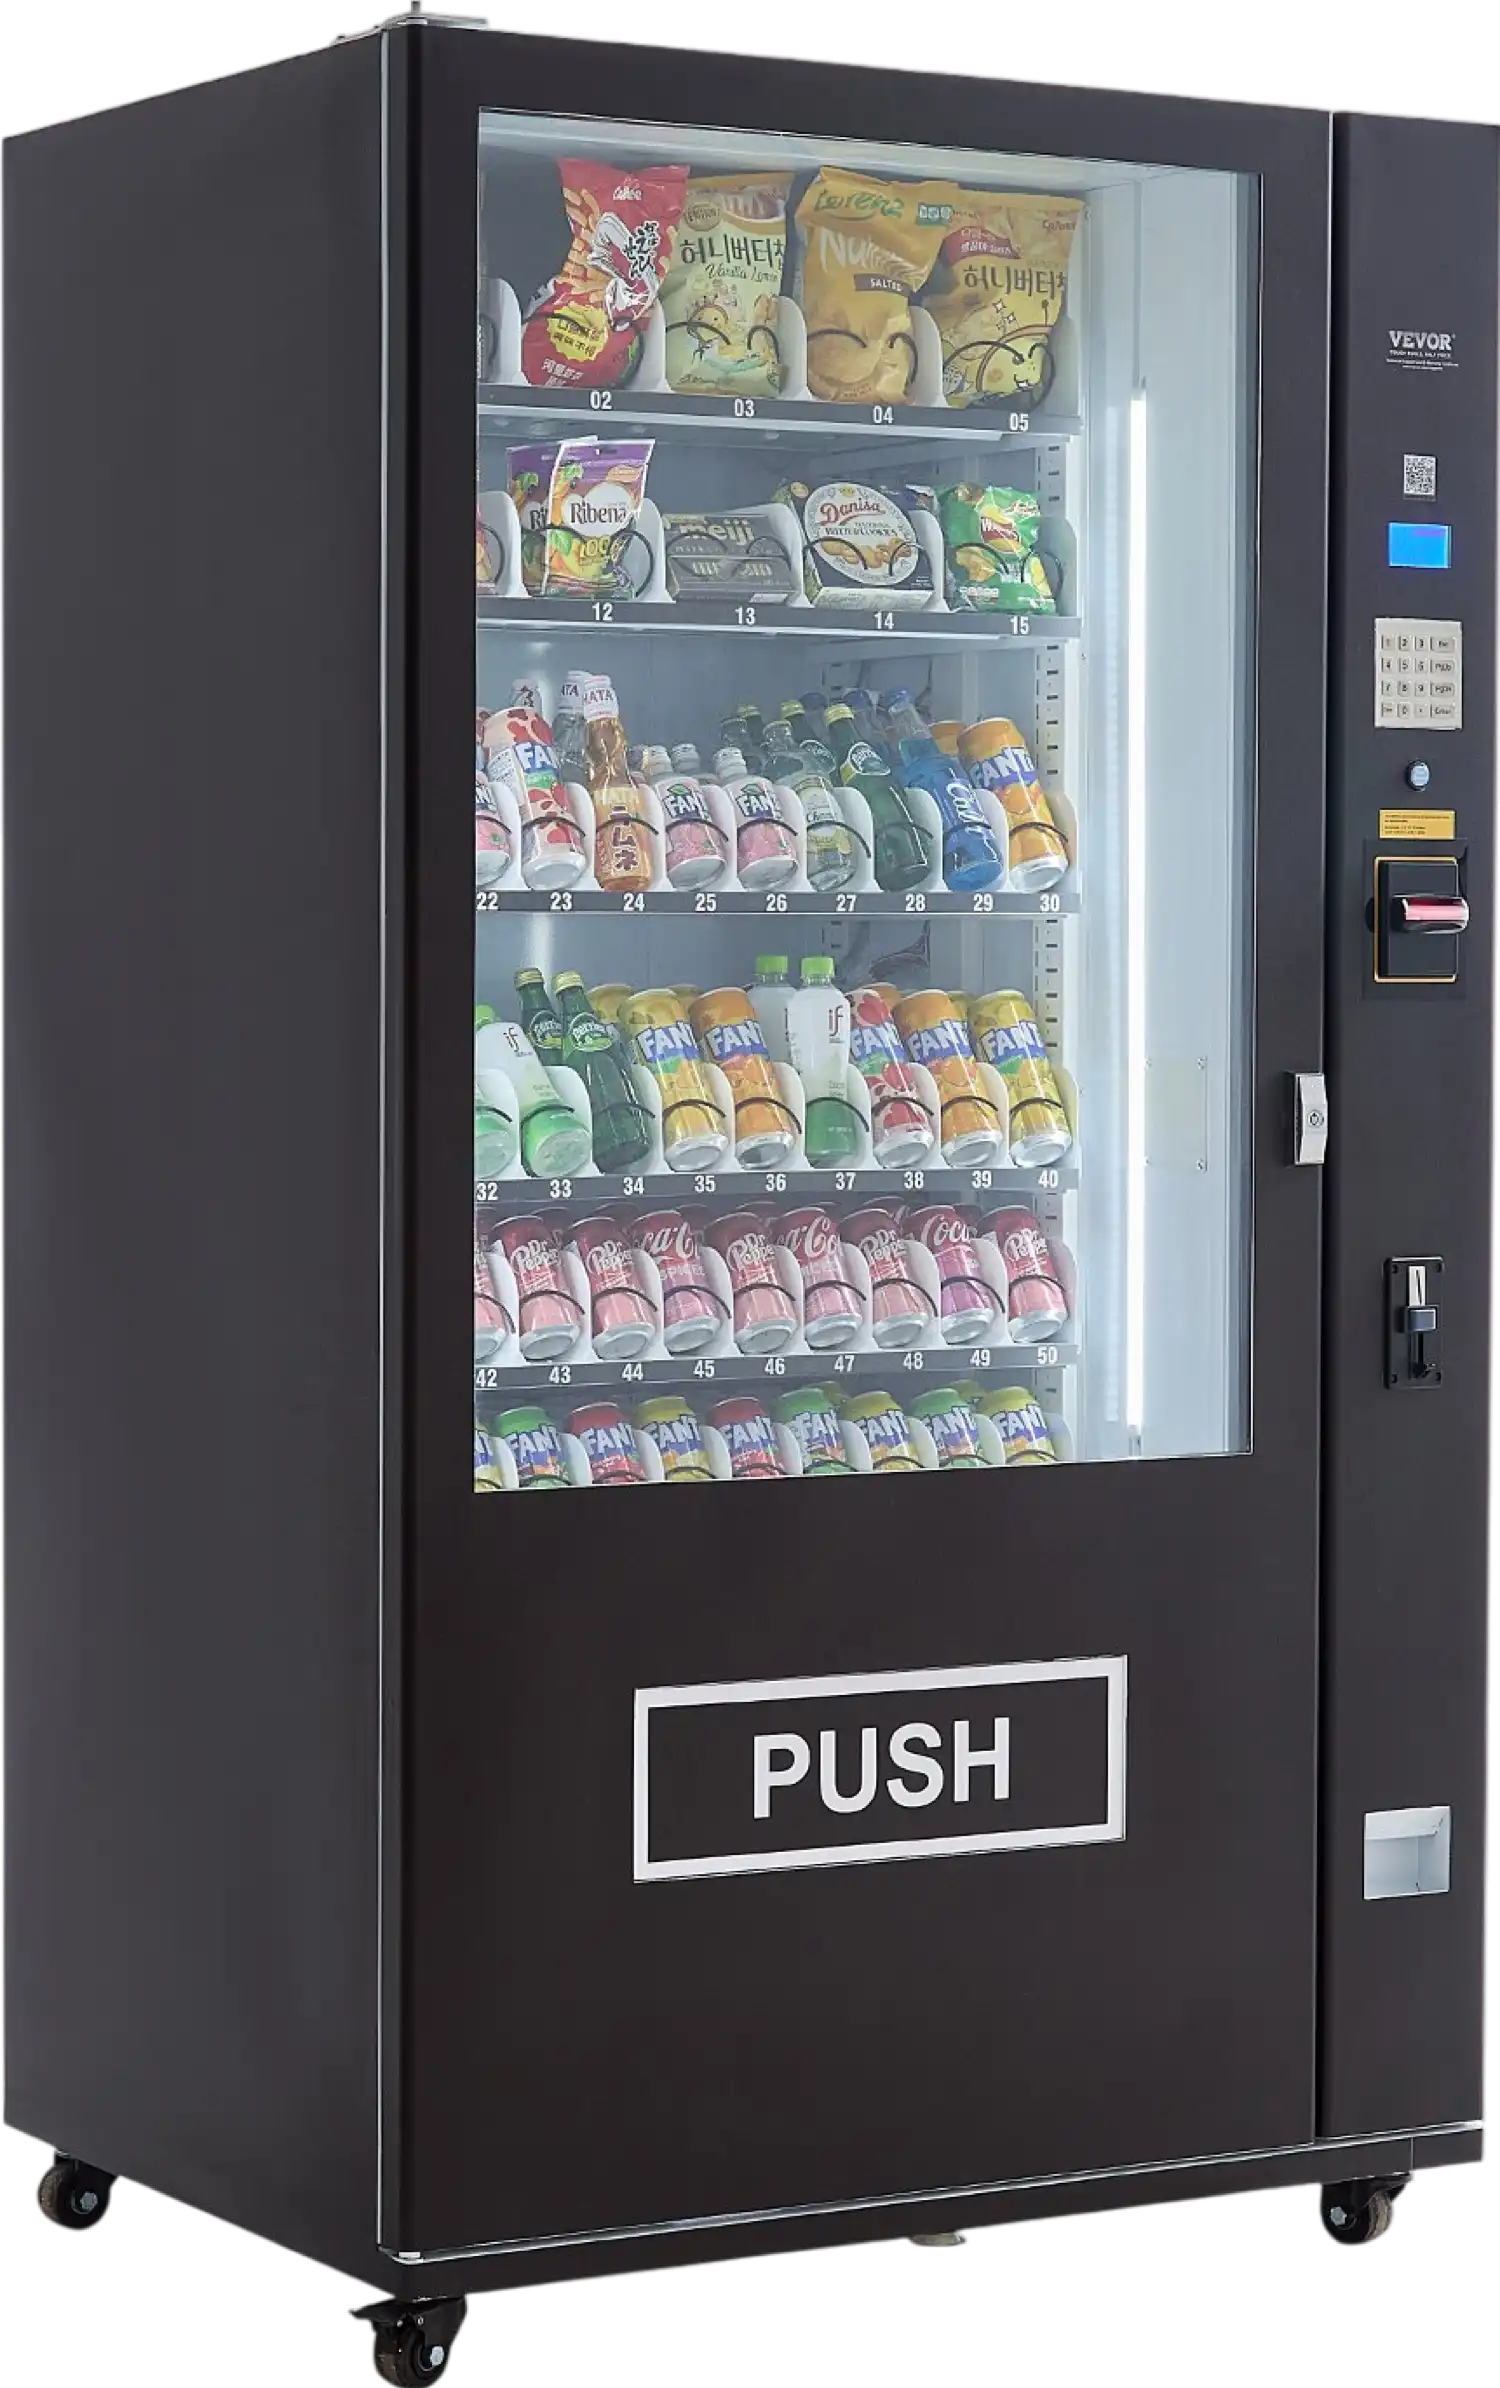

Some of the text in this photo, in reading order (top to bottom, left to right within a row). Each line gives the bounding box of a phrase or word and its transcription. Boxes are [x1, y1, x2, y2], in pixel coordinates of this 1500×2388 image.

[1388, 330, 1453, 351] VEVOR
[590, 391, 612, 410] 02
[734, 399, 755, 417] 03
[872, 406, 894, 424] 04
[1009, 413, 1029, 431] 05
[570, 502, 628, 524] Ribena
[818, 497, 886, 526] Danisa
[678, 518, 756, 546] meiji
[591, 602, 613, 621] 12
[734, 606, 756, 625] 13
[874, 611, 895, 630] 14
[1010, 617, 1029, 635] 15
[477, 892, 498, 911] 22
[550, 892, 572, 911] 23
[623, 892, 645, 911] 24
[695, 892, 717, 912] 25
[766, 893, 788, 912] 26
[836, 893, 857, 912] 27
[905, 893, 926, 912] 28
[973, 893, 994, 911] 29
[1039, 894, 1060, 912] 30
[829, 1005, 843, 1036] if
[623, 1177, 645, 1195] 34
[694, 1175, 717, 1193] 35
[765, 1173, 787, 1192] 36
[835, 1172, 856, 1190] 37
[903, 1171, 925, 1189] 38
[971, 1170, 993, 1188] 39
[1038, 1170, 1059, 1188] 40
[477, 1182, 499, 1201] 32
[550, 1180, 572, 1198] 33
[834, 1354, 855, 1373] 47
[903, 1352, 924, 1370] 48
[970, 1349, 991, 1367] 49
[1037, 1346, 1058, 1365] 50
[549, 1366, 571, 1384] 43
[622, 1363, 644, 1381] 44
[693, 1360, 715, 1378] 45
[764, 1358, 785, 1376] 46
[477, 1369, 498, 1388] 42
[752, 1716, 1011, 1820] PUSH
